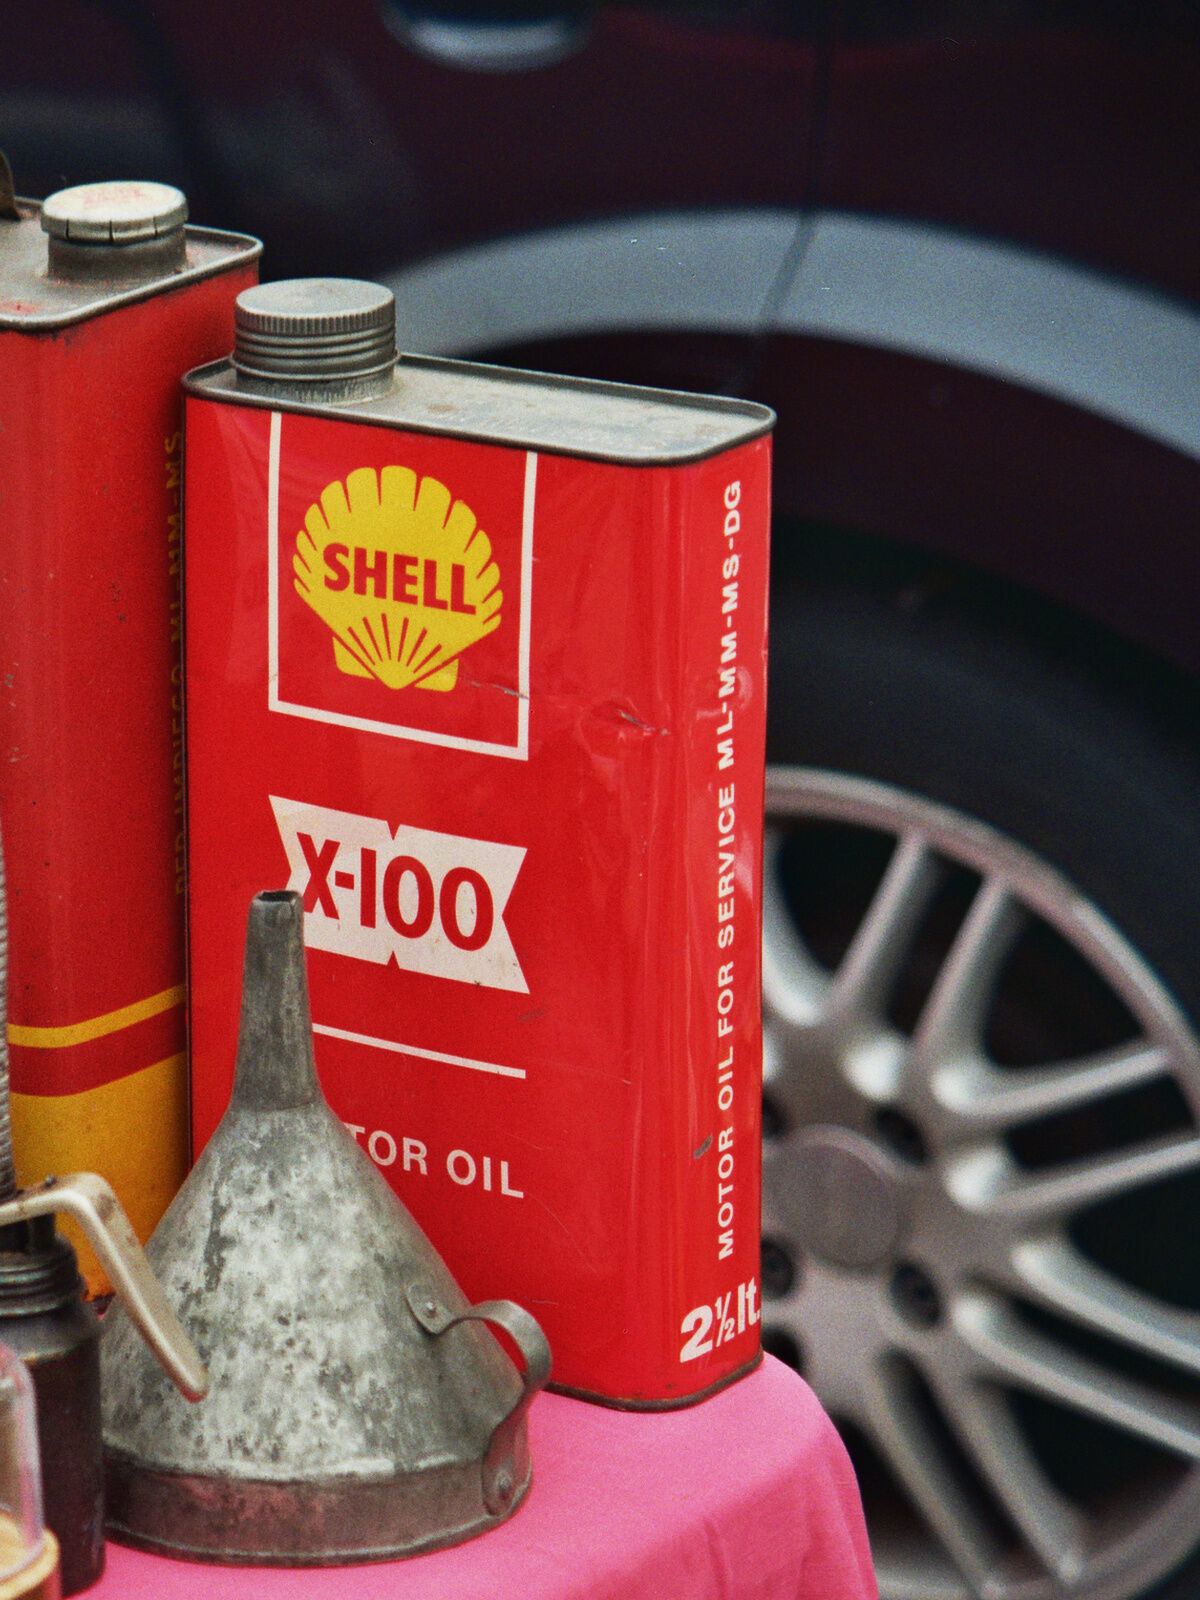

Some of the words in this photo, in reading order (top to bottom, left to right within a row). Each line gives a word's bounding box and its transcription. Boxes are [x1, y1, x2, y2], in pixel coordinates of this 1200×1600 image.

[322, 541, 477, 616] SHELL
[295, 831, 494, 952] X-100
[717, 782, 736, 944] SERVICE
[717, 961, 735, 1037] FOR
[717, 1050, 735, 1111] OIL
[446, 1148, 526, 1200] OIL
[717, 1125, 735, 1261] MOTOR
